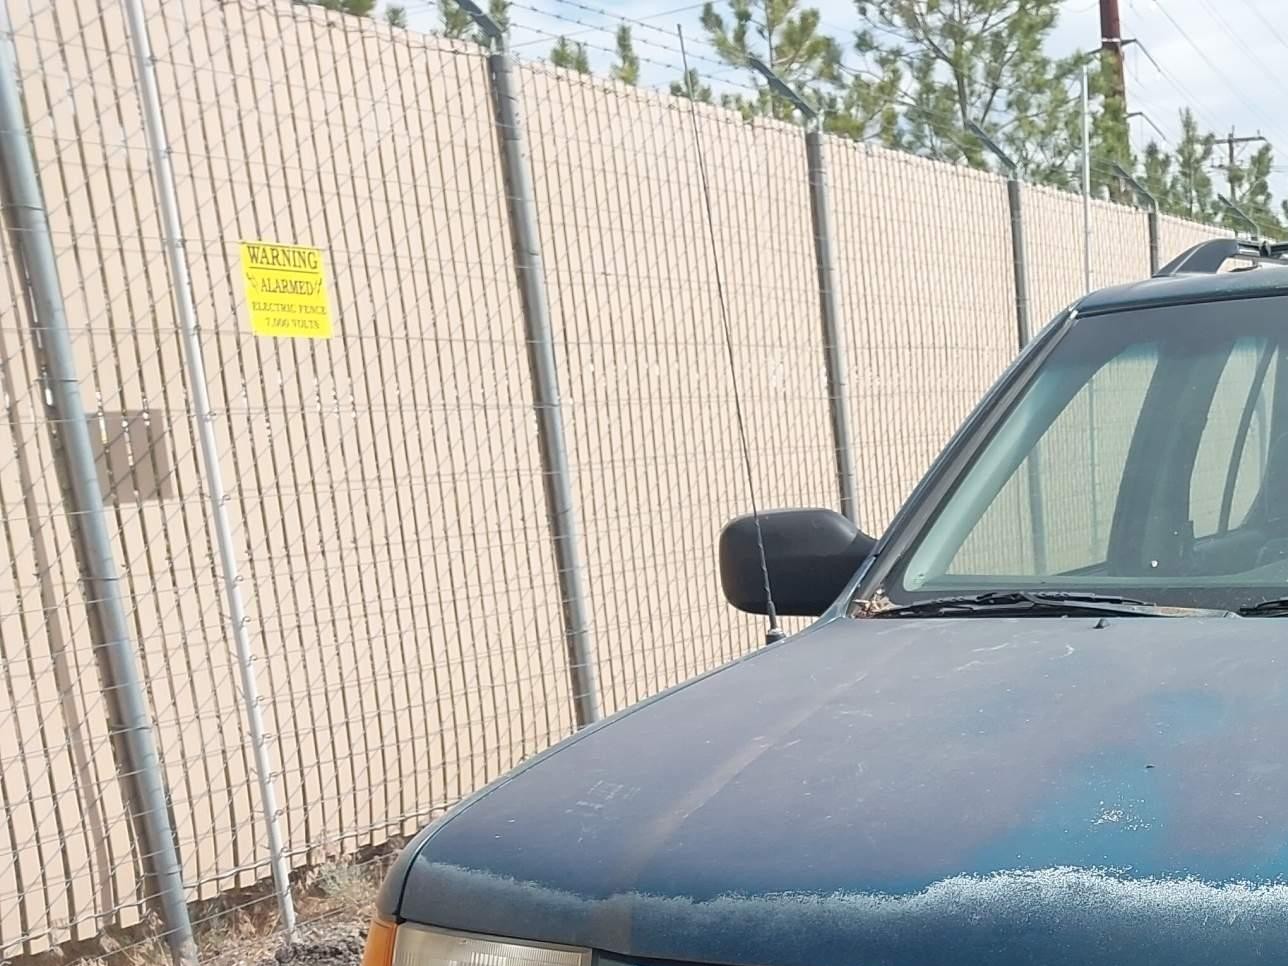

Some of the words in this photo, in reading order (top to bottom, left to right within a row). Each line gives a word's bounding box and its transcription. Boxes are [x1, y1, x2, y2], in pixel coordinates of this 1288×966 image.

[247, 245, 318, 270] WARNING
[260, 277, 314, 296] ALARMED
[252, 301, 296, 314] ELECTRIC
[298, 304, 327, 316] FENCE
